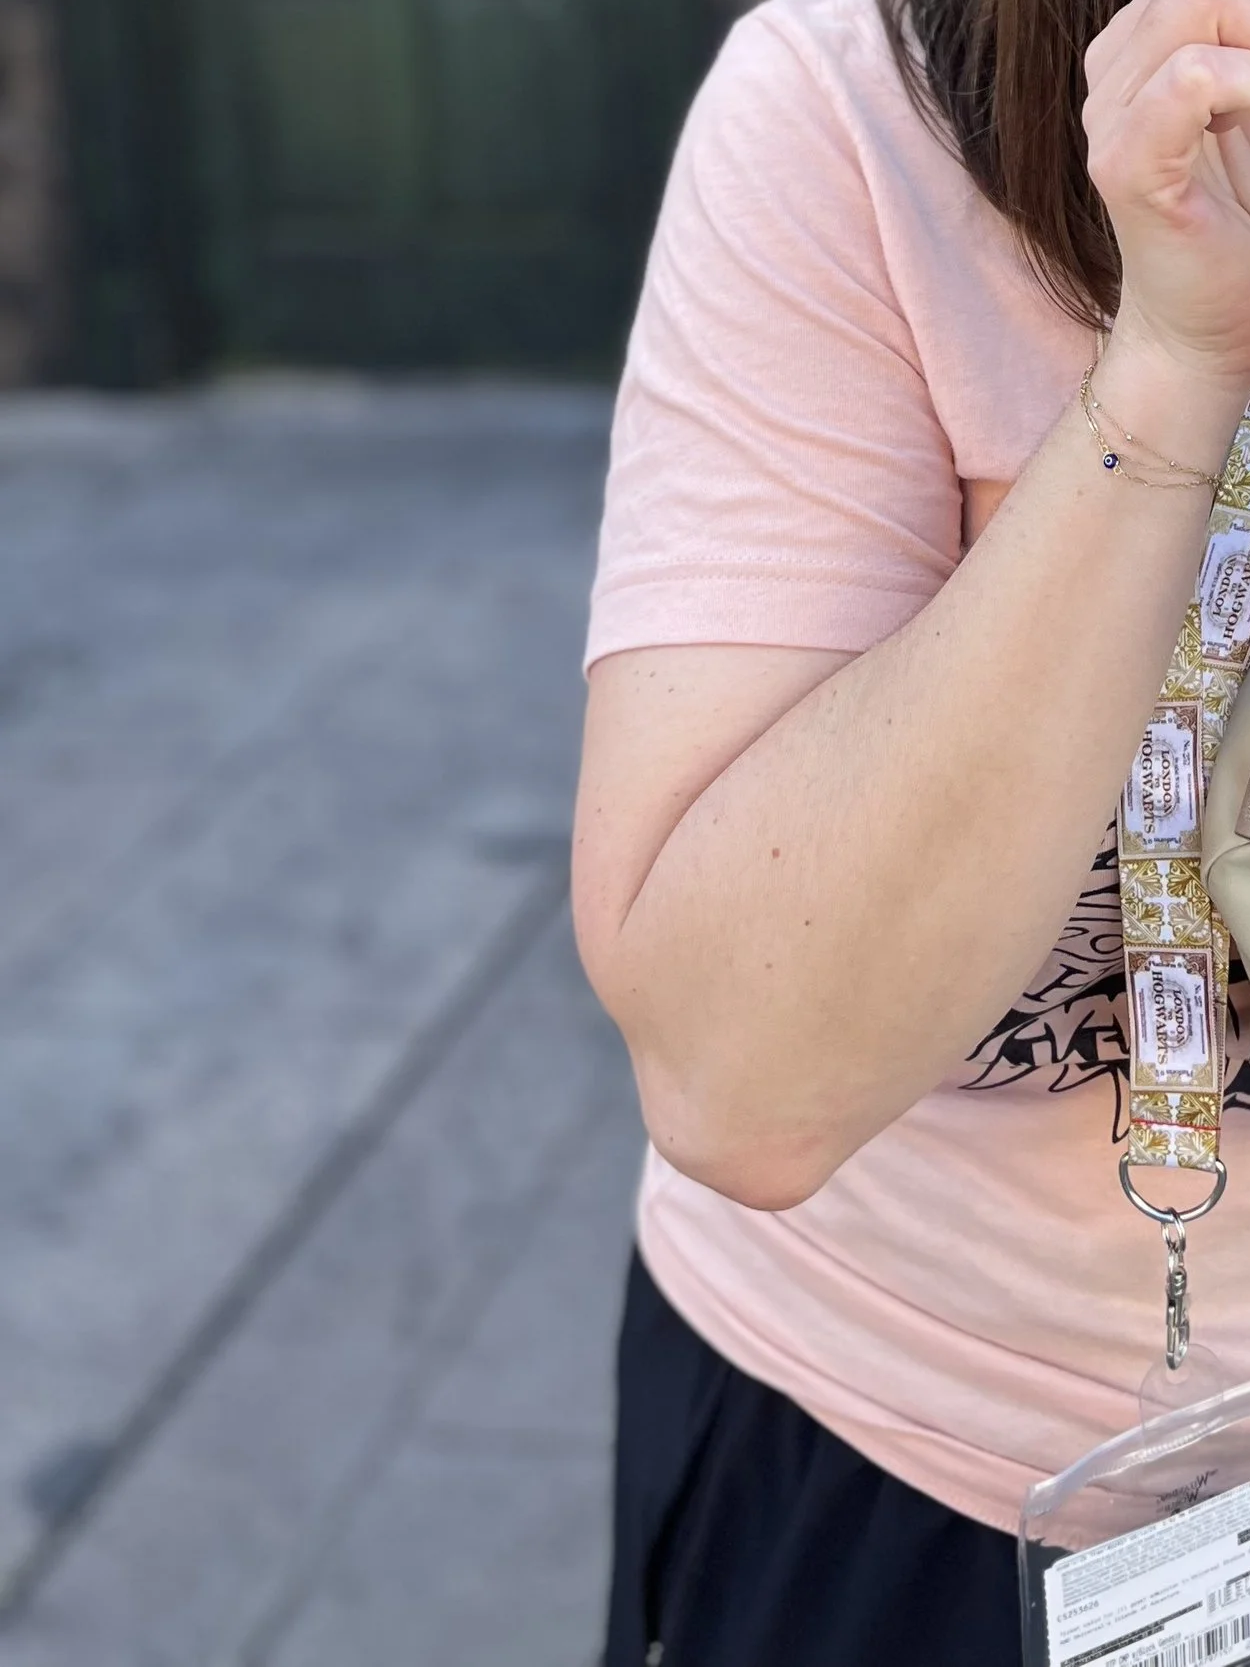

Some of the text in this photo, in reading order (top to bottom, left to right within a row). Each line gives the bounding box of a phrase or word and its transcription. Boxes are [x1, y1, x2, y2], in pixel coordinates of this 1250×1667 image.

[1212, 557, 1237, 616] LONDON
[1141, 730, 1155, 834] HOGWARTS
[1161, 750, 1173, 813] LONDON
[1152, 970, 1169, 1065] HOGWARTS
[1173, 989, 1185, 1044] LONDON
